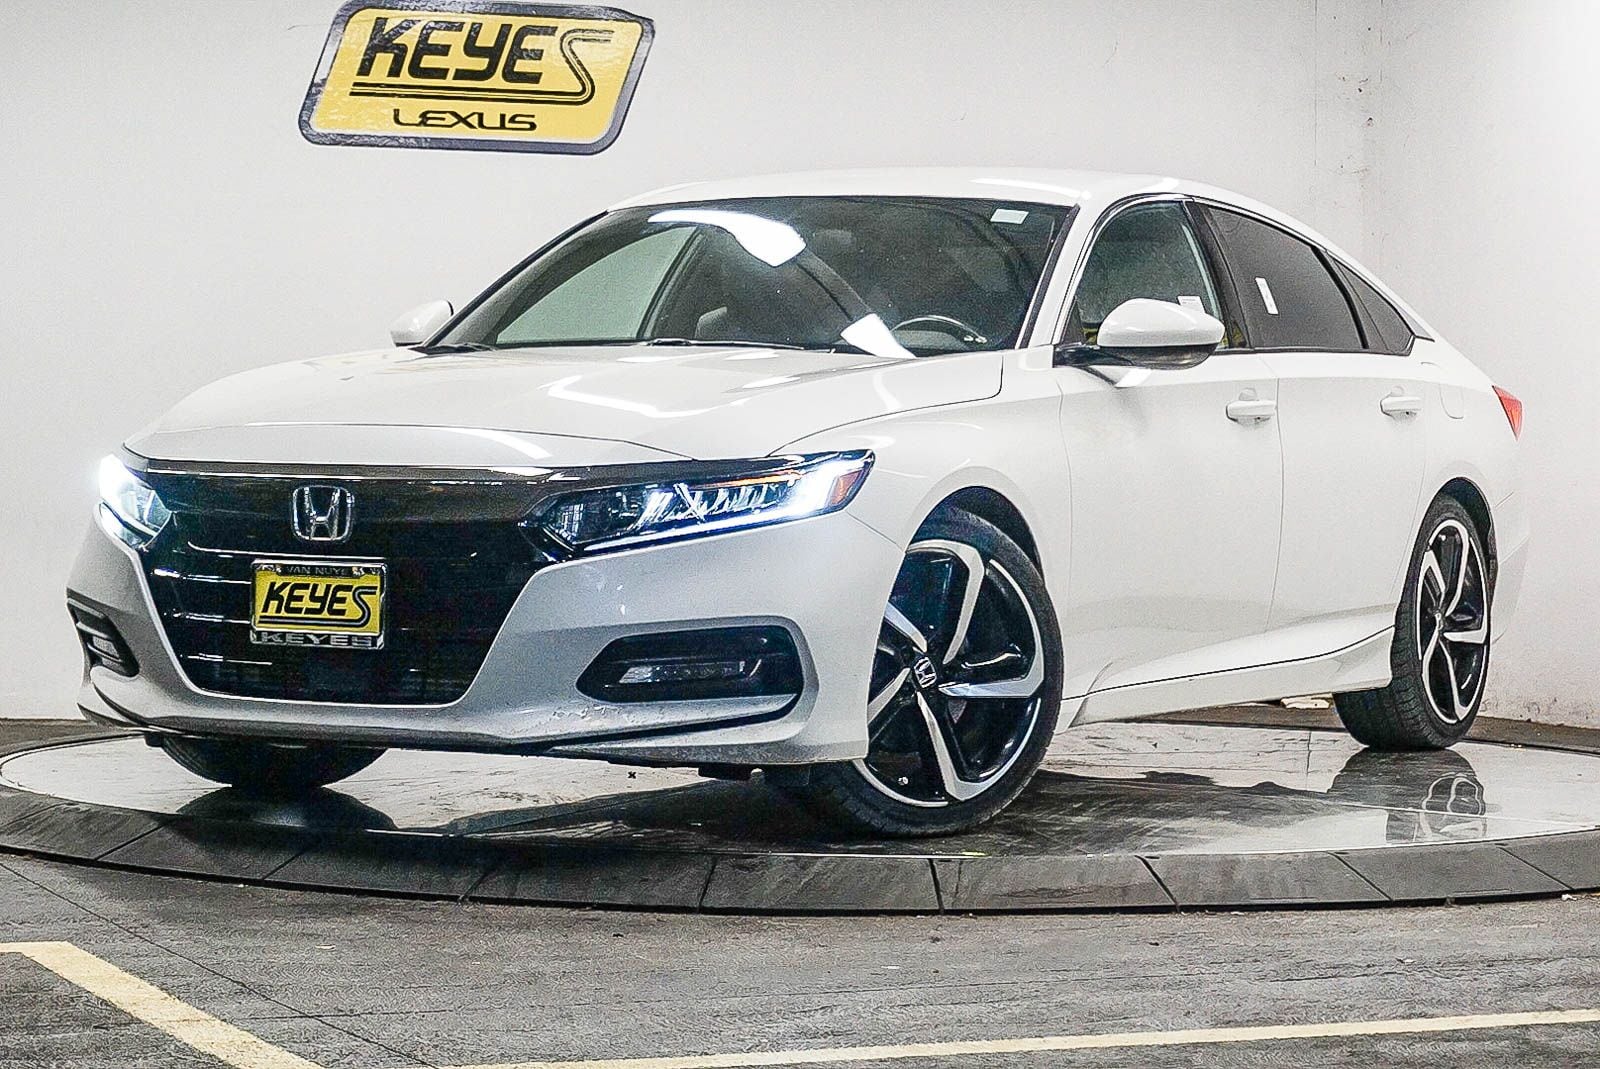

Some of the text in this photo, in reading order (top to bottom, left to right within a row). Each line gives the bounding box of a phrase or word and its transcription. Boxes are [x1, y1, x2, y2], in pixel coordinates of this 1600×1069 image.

[350, 17, 615, 106] KEYES
[394, 109, 537, 131] LEXUS
[287, 566, 311, 575] VAN
[258, 581, 378, 627] KEYES
[261, 633, 372, 647] KEYES
